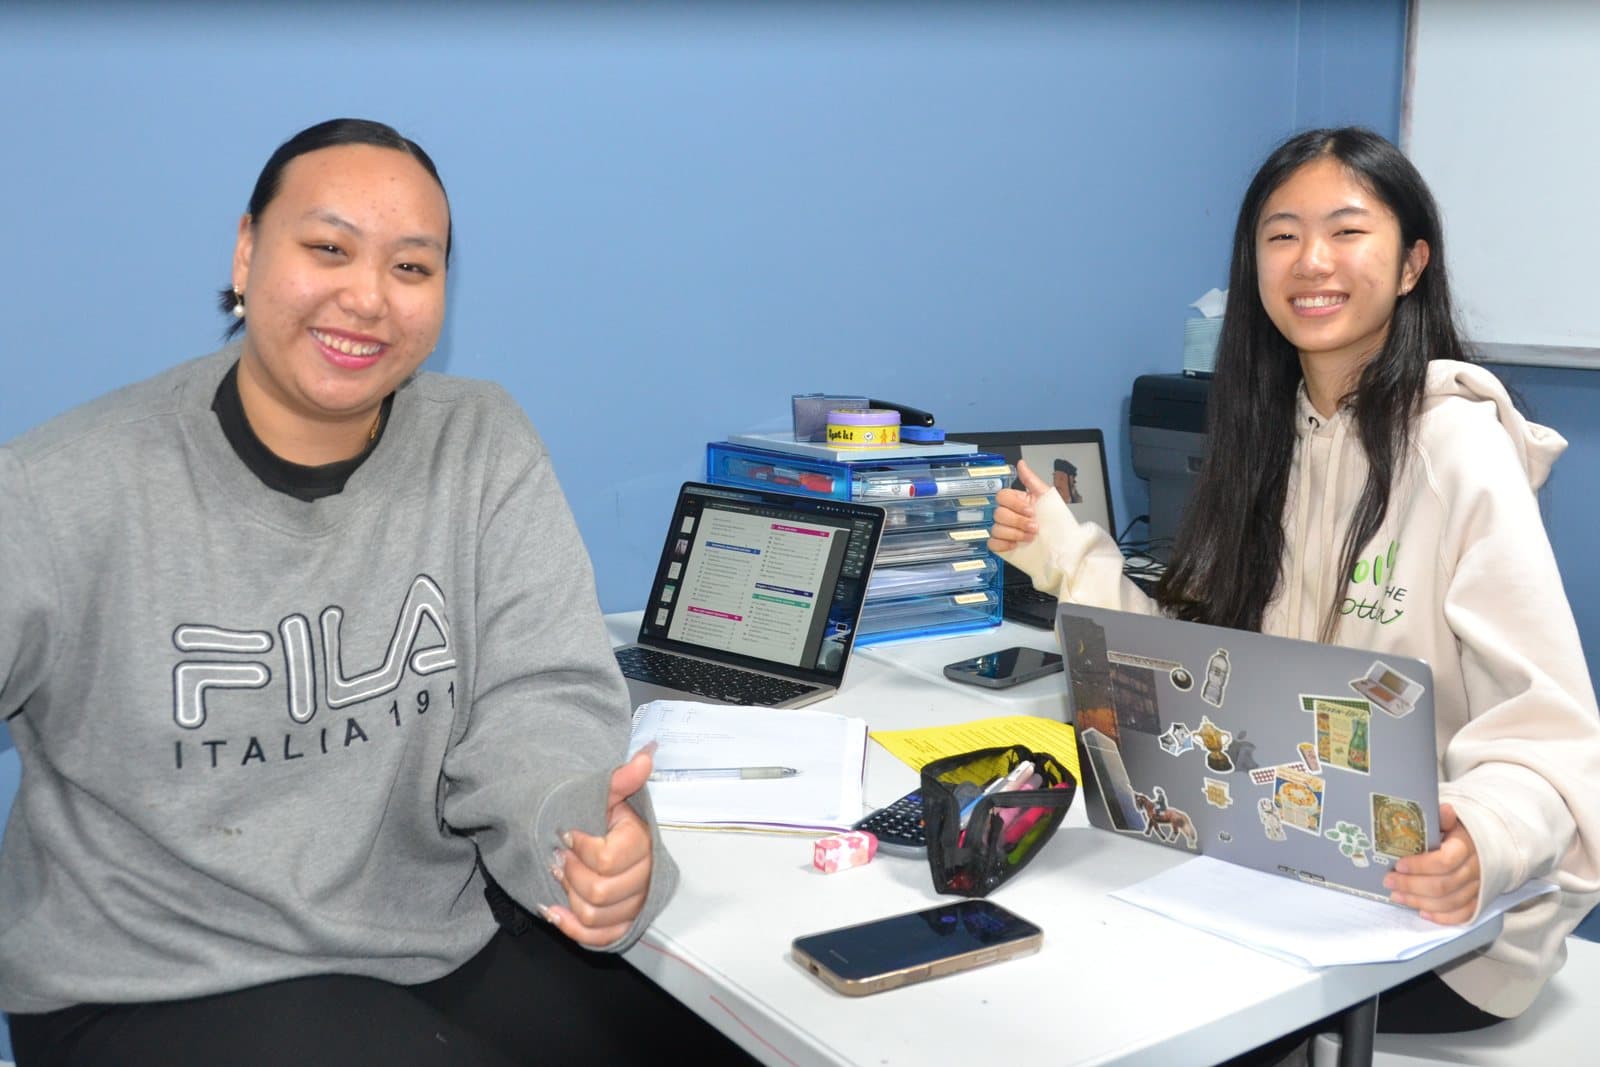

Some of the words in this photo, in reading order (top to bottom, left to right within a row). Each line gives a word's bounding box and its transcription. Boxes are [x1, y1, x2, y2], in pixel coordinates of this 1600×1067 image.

[172, 574, 456, 730] FILA
[174, 717, 369, 769] ITALIA
[389, 681, 456, 727] 191
